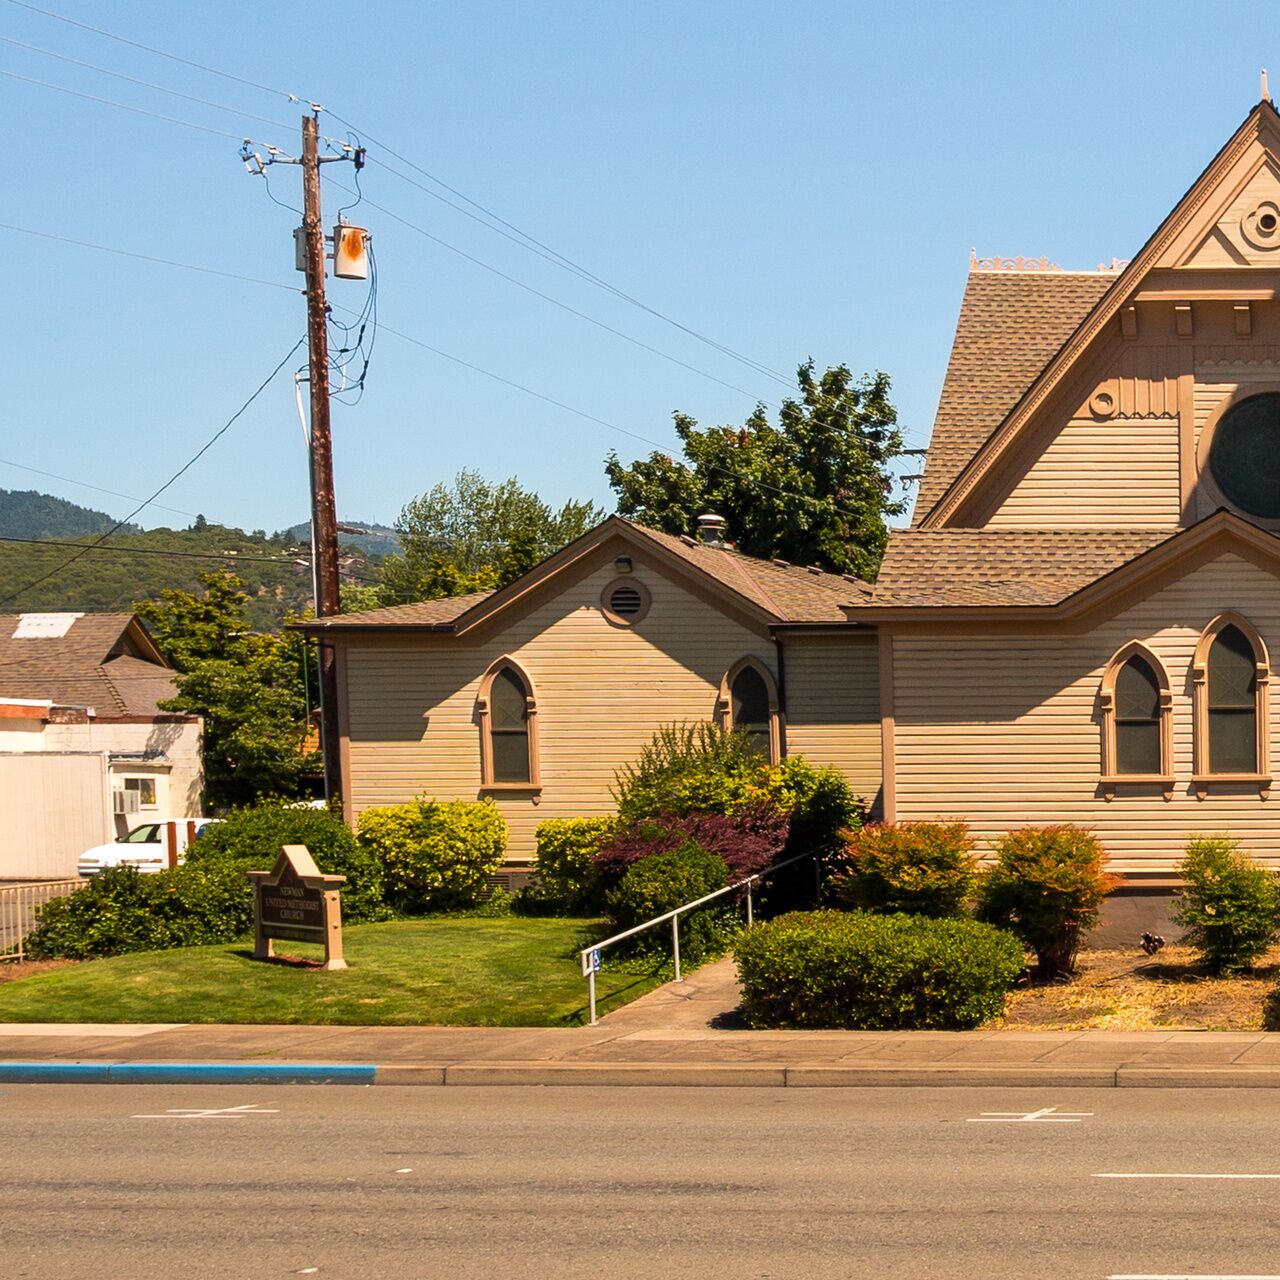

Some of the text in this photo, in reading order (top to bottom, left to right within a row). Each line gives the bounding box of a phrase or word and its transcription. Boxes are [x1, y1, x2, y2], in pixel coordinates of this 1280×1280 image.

[280, 887, 304, 897] NEWMAN
[266, 897, 320, 911] UNITED METHODIST
[280, 909, 304, 920] CHURCH
